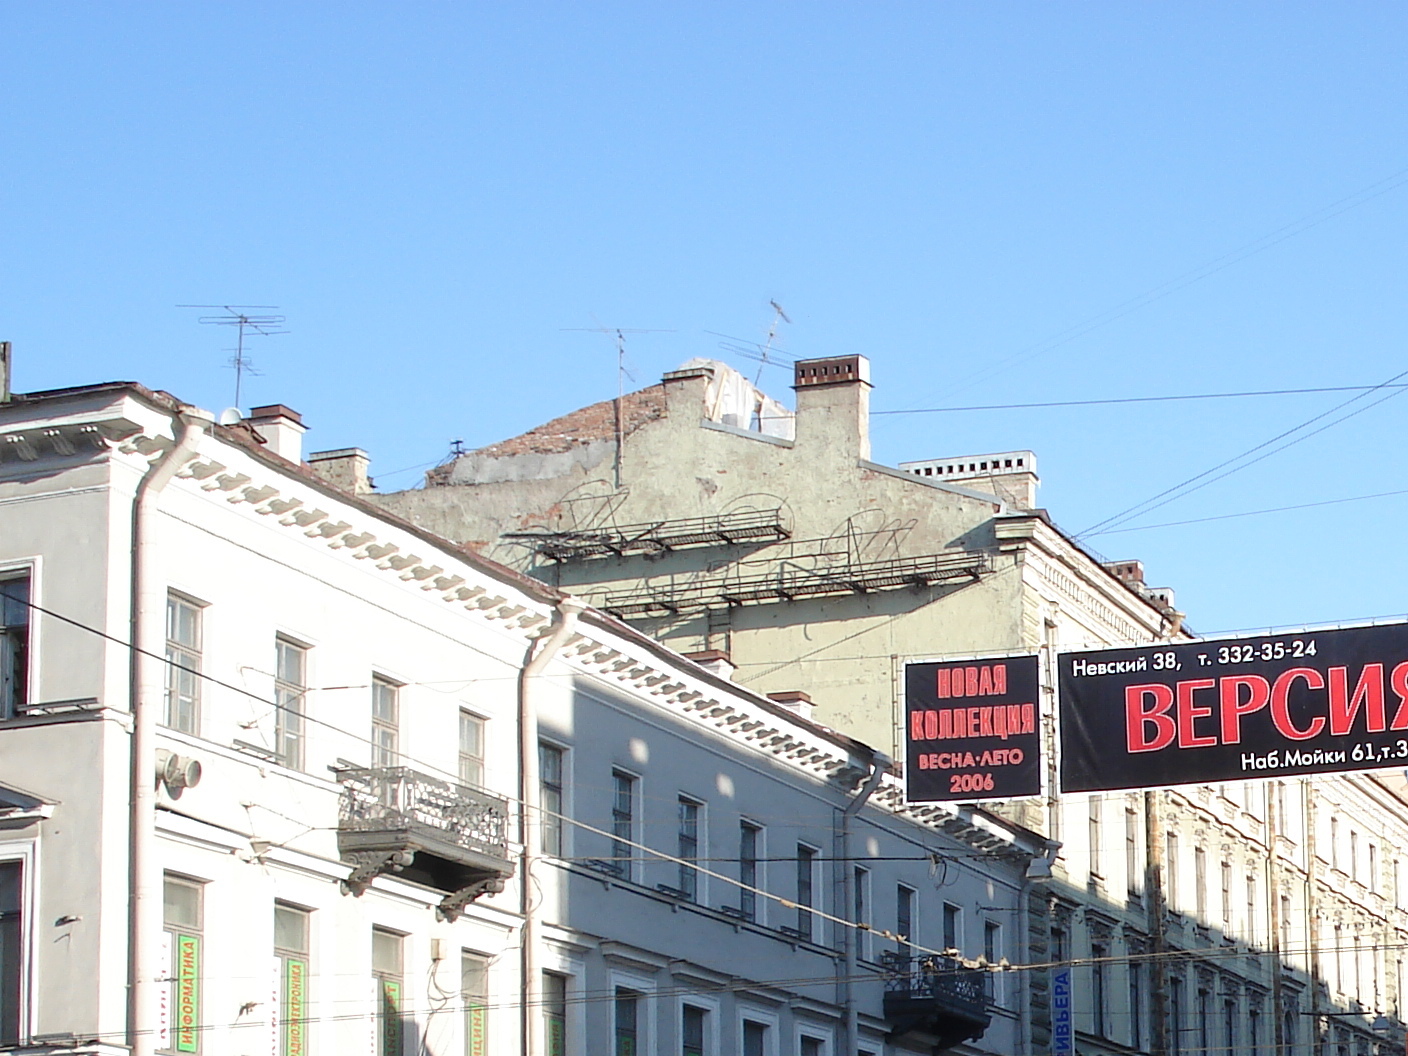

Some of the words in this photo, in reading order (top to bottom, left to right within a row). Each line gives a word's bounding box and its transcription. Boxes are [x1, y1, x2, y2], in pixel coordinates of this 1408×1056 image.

[1073, 657, 1147, 677] Невский
[1153, 653, 1182, 671] 38,
[1198, 653, 1212, 666] т.
[1218, 640, 1317, 664] 332-35-24
[938, 665, 1007, 698] НОВАЯ
[911, 704, 1035, 740] КОЛЛЕКЦИЯ
[1241, 750, 1346, 771] Наб.Мойки
[950, 773, 994, 792] 2006
[182, 941, 195, 1044] ИНФОРМАТИКА
